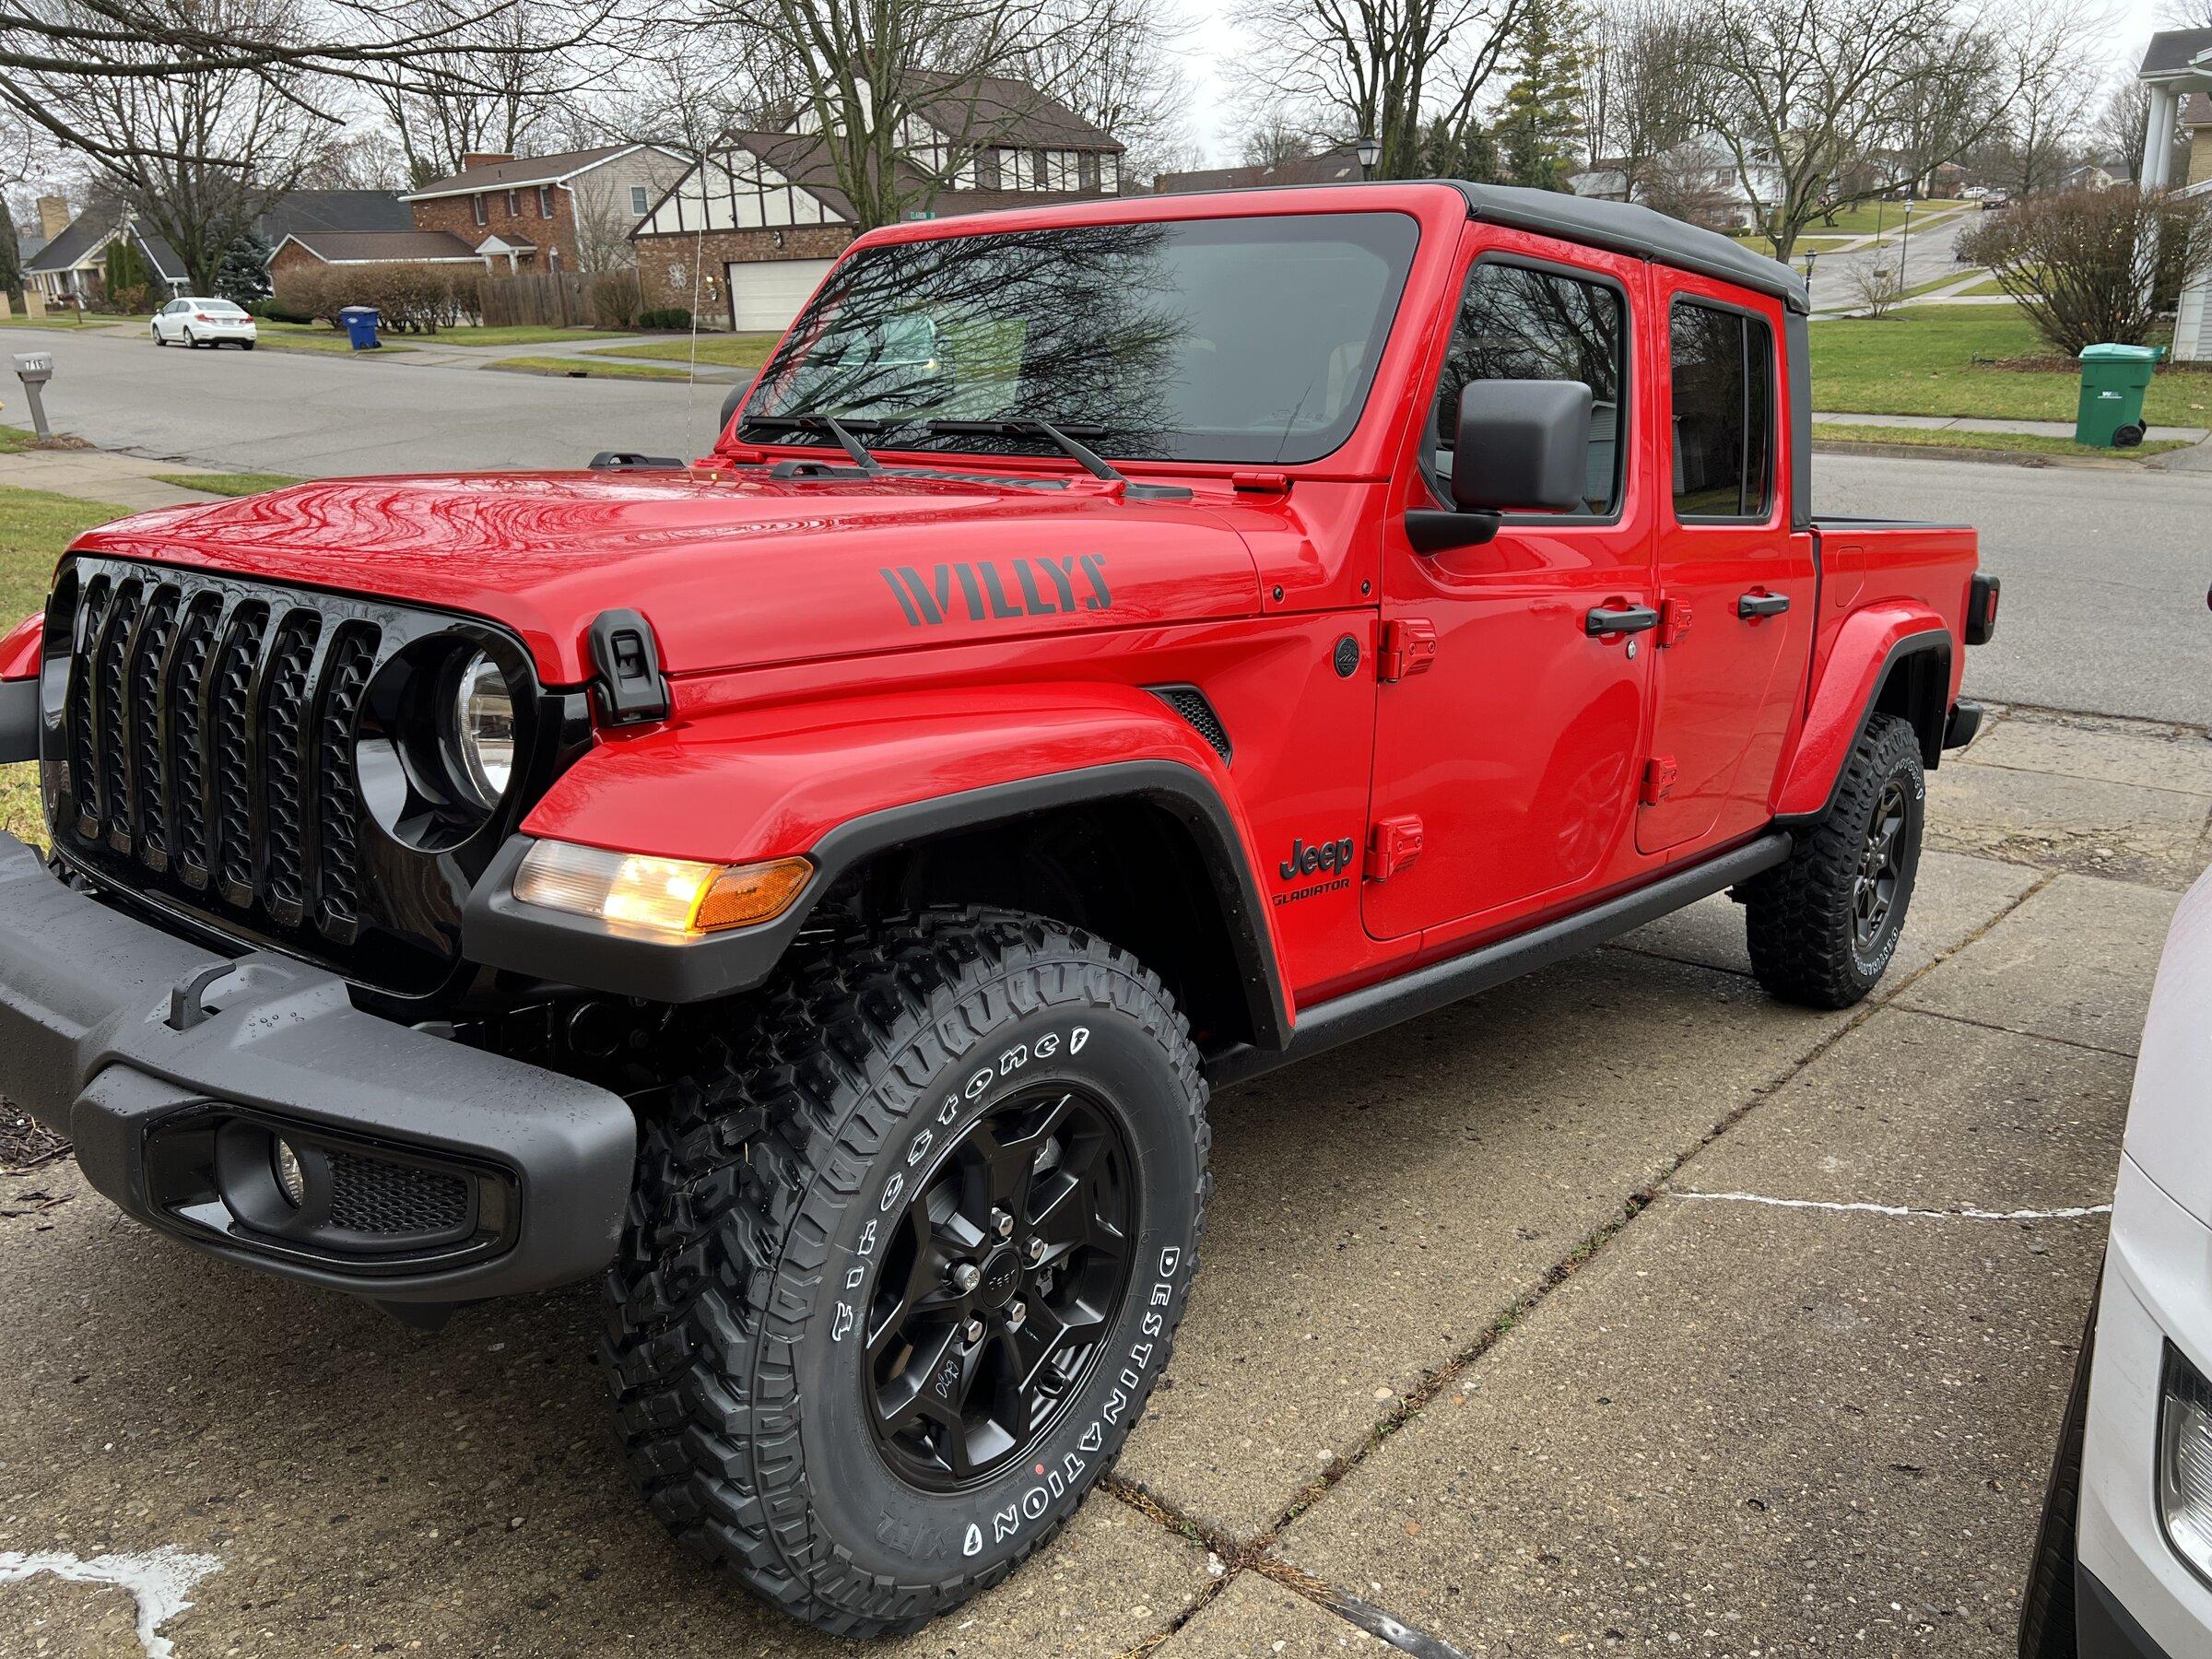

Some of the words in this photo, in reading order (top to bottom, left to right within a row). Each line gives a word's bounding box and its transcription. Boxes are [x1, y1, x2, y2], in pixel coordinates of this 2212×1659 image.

[878, 553, 1112, 628] WILLYS
[1279, 838, 1354, 880] Jeep
[1272, 877, 1350, 907] GLADIATOR
[994, 1245, 1181, 1545] DESTINATION
